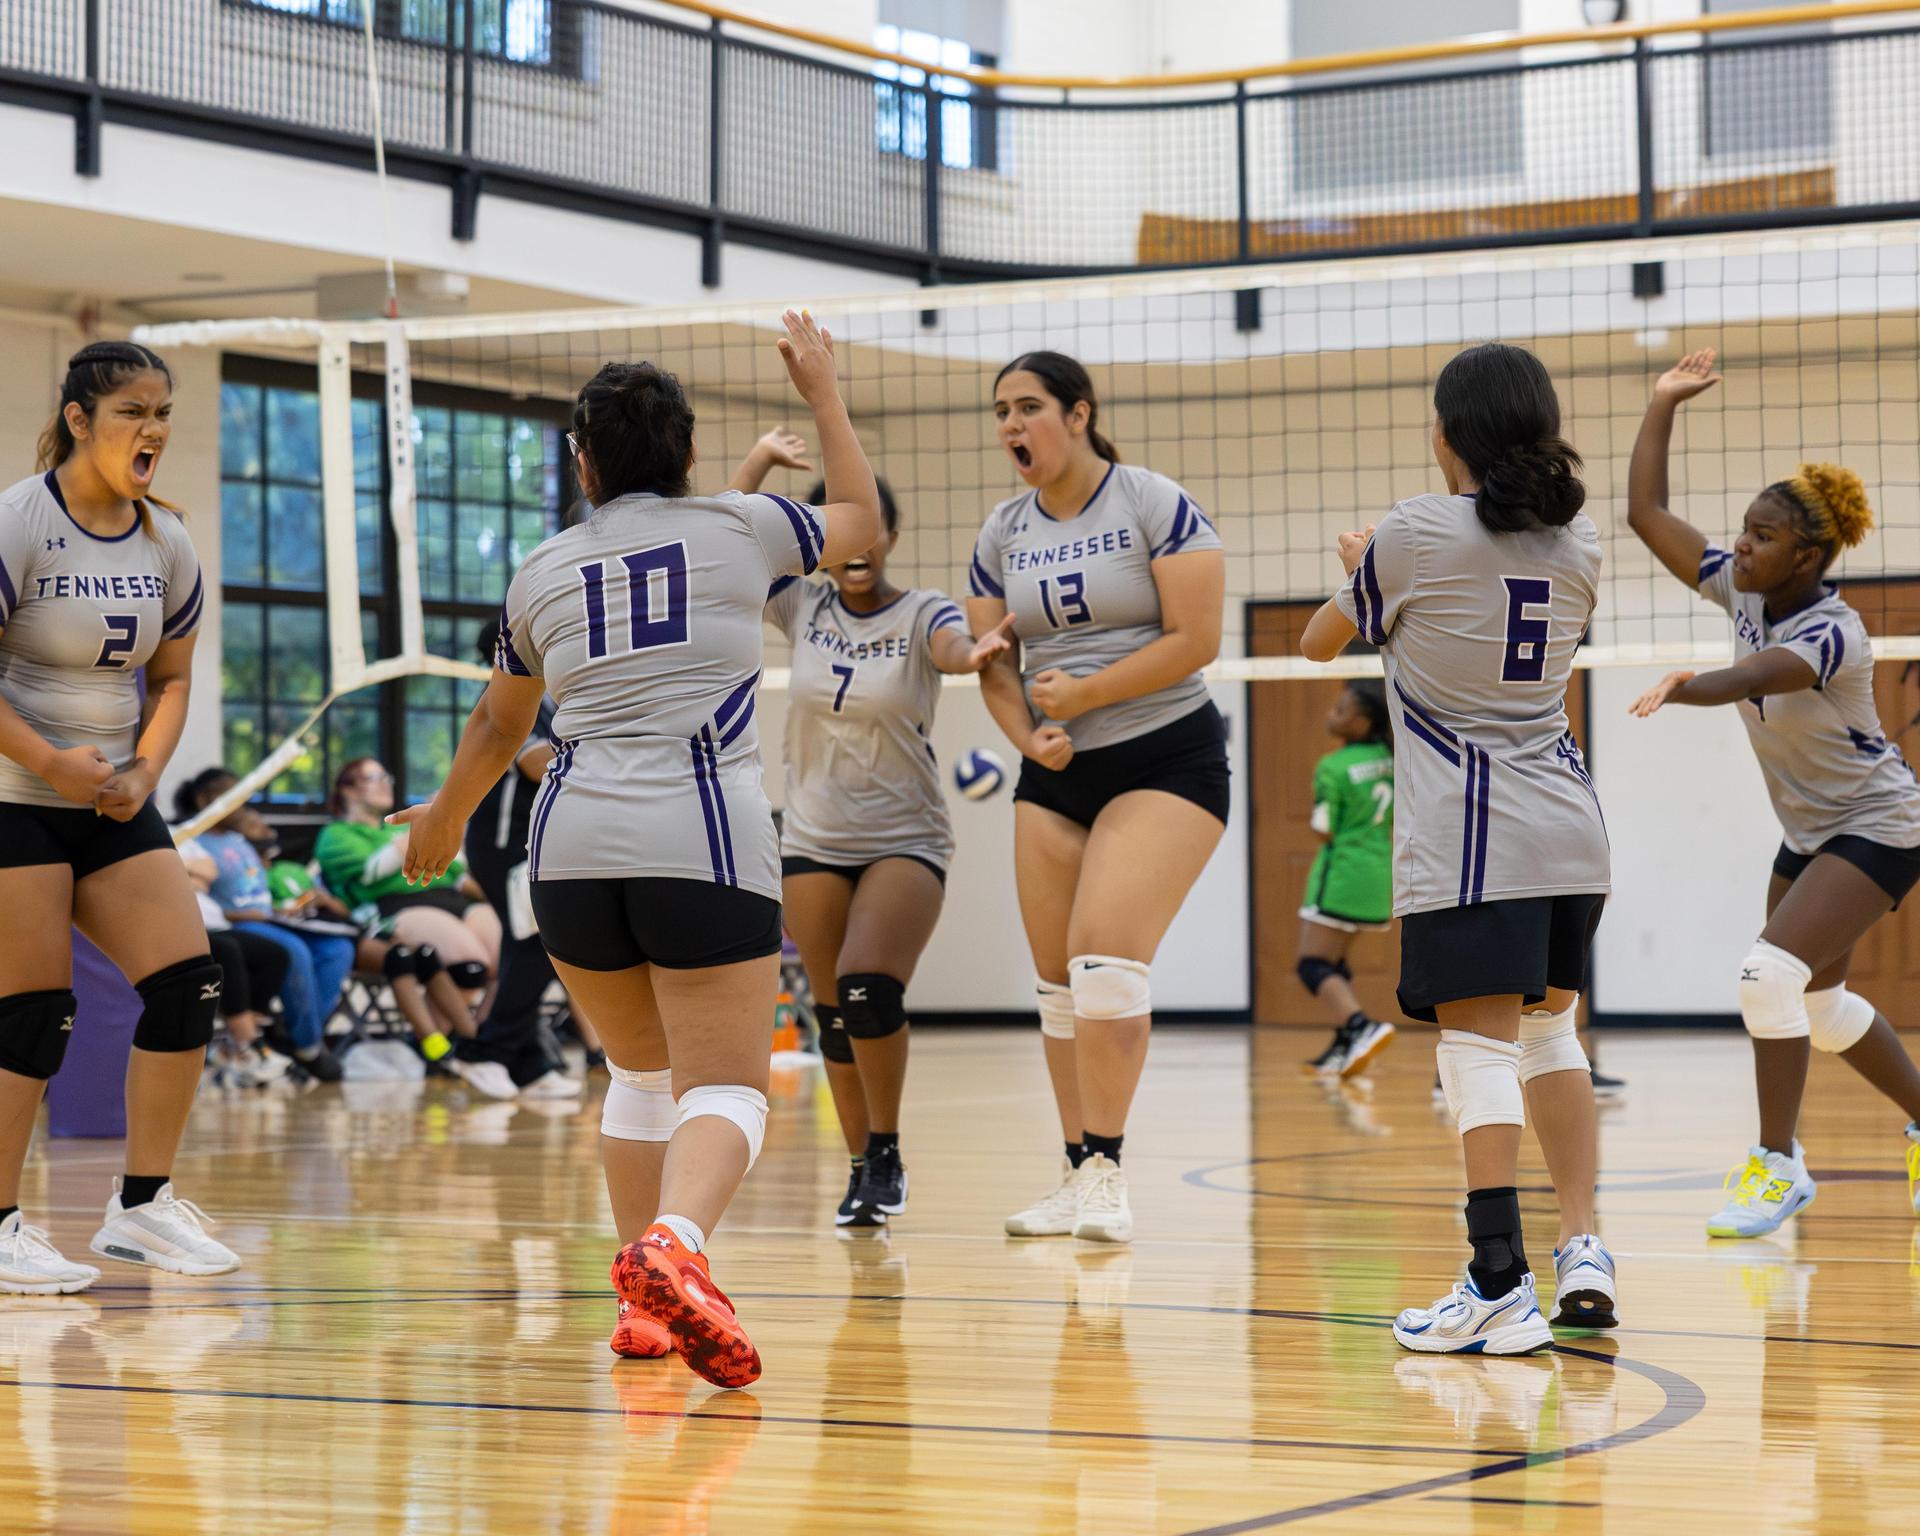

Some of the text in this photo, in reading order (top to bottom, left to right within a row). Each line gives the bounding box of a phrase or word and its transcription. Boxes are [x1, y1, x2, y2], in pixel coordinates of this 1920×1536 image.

[1007, 528, 1132, 571] TENNESSEE
[576, 539, 692, 663] 10
[1037, 571, 1094, 629] 13
[92, 614, 140, 670] 2
[1499, 575, 1552, 684] 6
[830, 662, 856, 714] 7
